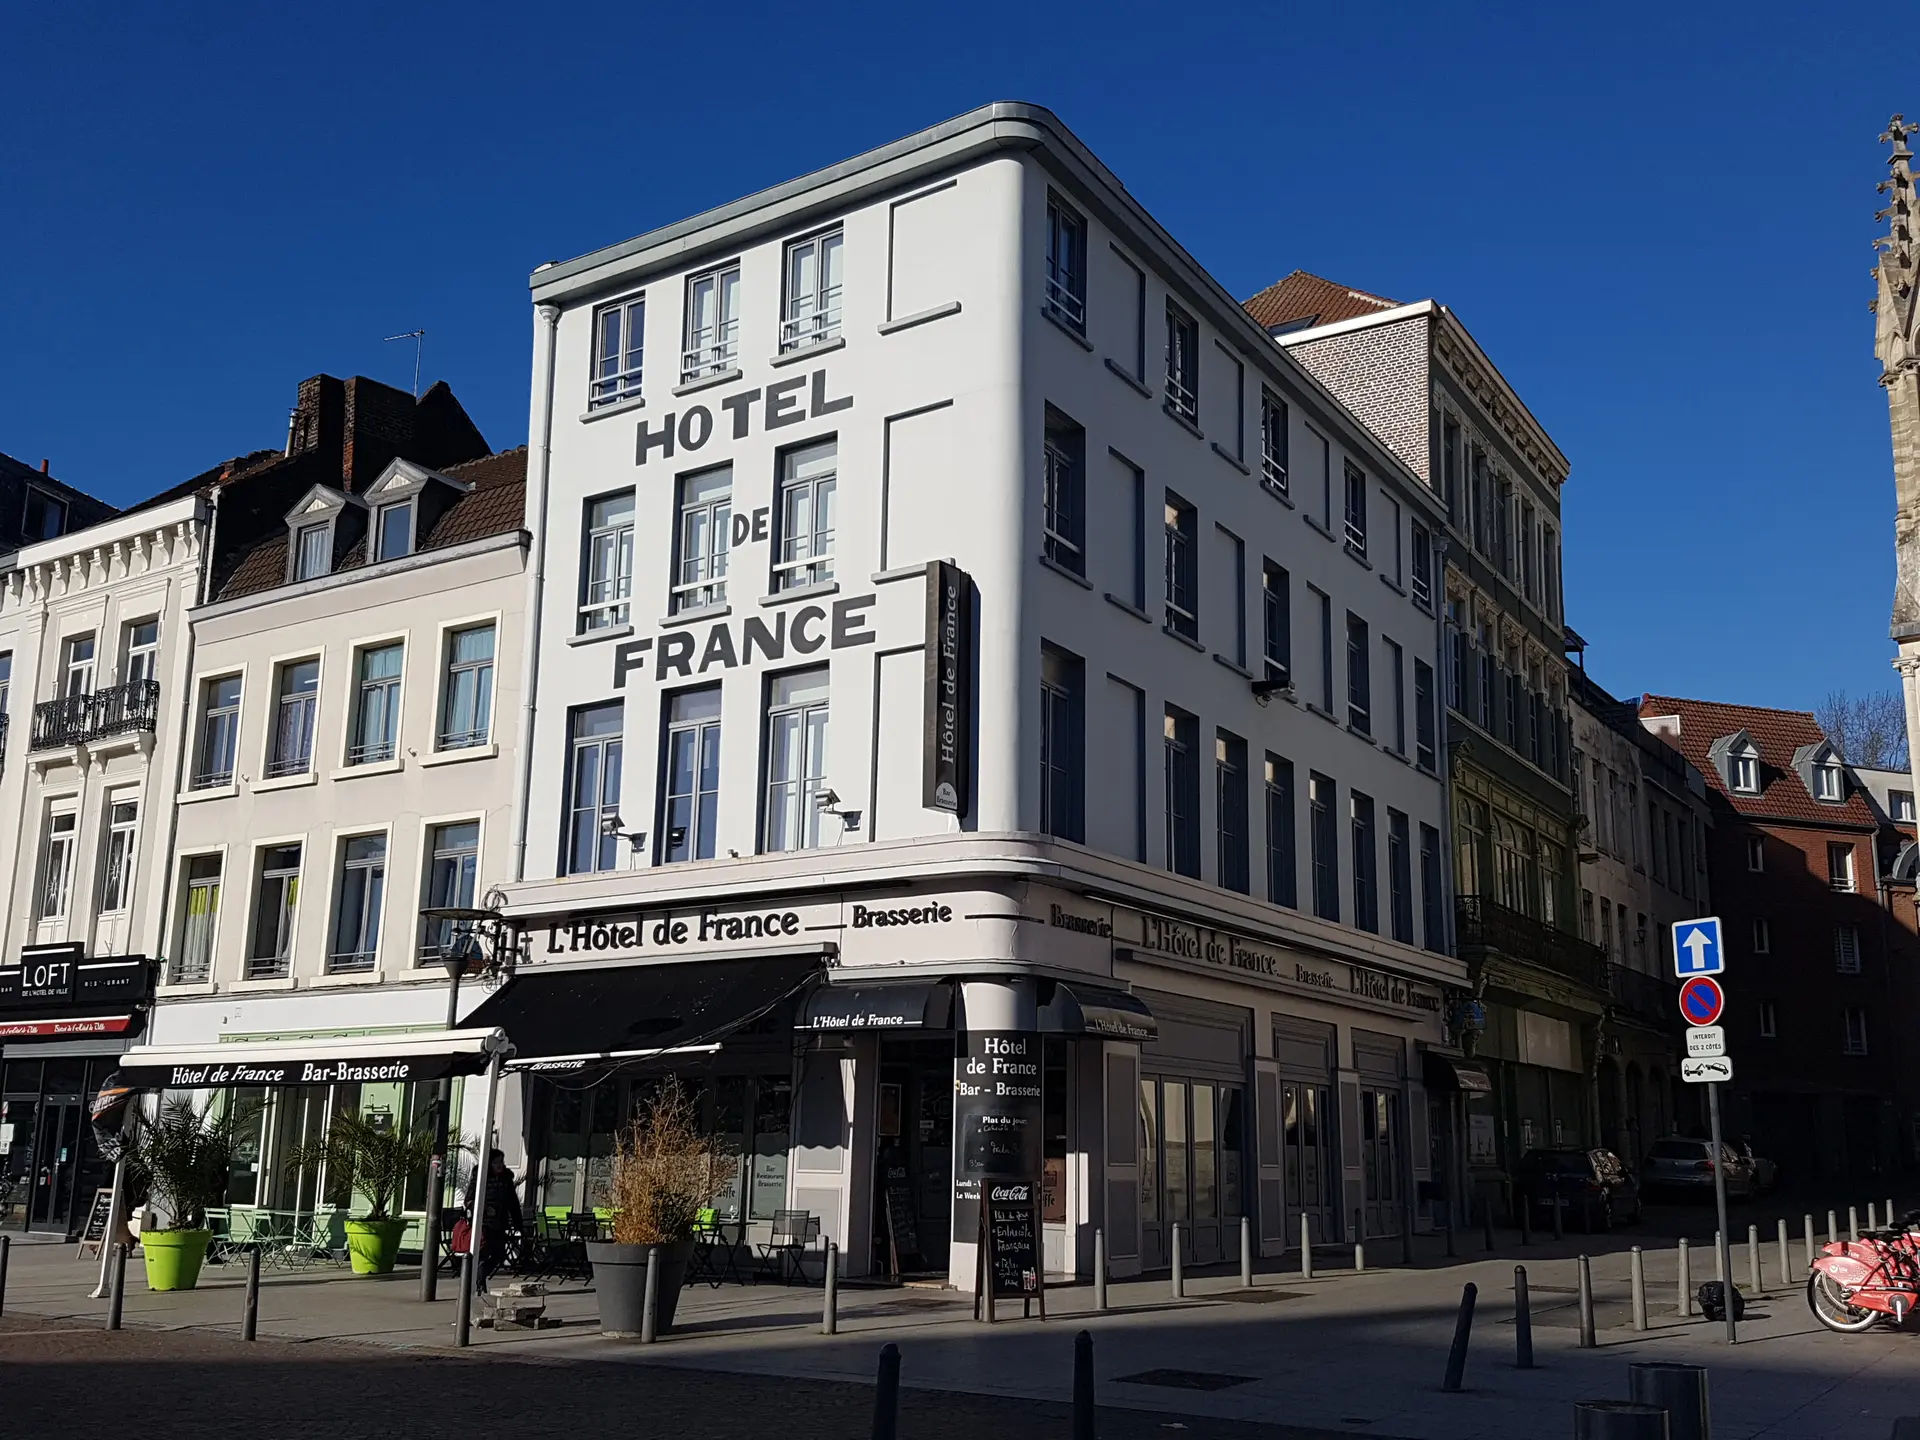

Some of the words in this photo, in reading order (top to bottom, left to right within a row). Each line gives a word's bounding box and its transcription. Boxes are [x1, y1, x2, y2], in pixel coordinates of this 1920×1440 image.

[635, 369, 854, 466] HOTEL
[732, 506, 769, 547] DE
[943, 586, 957, 660] France
[613, 593, 876, 689] FRANCE
[941, 667, 955, 695] de
[941, 702, 955, 764] Hôtel
[851, 901, 952, 928] Brasserie
[1050, 903, 1112, 938] Brasserie
[547, 911, 643, 954] L'Hôtel
[653, 910, 688, 945] de
[698, 907, 800, 942] France
[1141, 915, 1203, 959] L'Hôtel
[1207, 930, 1227, 964] de
[1229, 936, 1277, 975] France
[22, 962, 71, 988] LOFT
[1295, 963, 1334, 989] Brasserie
[1391, 979, 1406, 1004] de
[812, 1014, 850, 1028] L'Hôtel
[851, 1013, 865, 1027] de
[867, 1013, 904, 1026] France
[984, 1037, 1027, 1055] Hôtel
[171, 1065, 210, 1085] Hôtel
[211, 1064, 230, 1082] de
[231, 1065, 284, 1081] France
[301, 1060, 409, 1081] Bar-Brasserie
[966, 1056, 986, 1075] de
[992, 1057, 1037, 1075] France
[959, 1081, 981, 1096] Bar
[995, 1081, 1041, 1097] Brasserie
[982, 1115, 999, 1124] Plat
[1000, 1115, 1011, 1124] du
[956, 1179, 972, 1187] Lundi
[956, 1191, 963, 1199] Le
